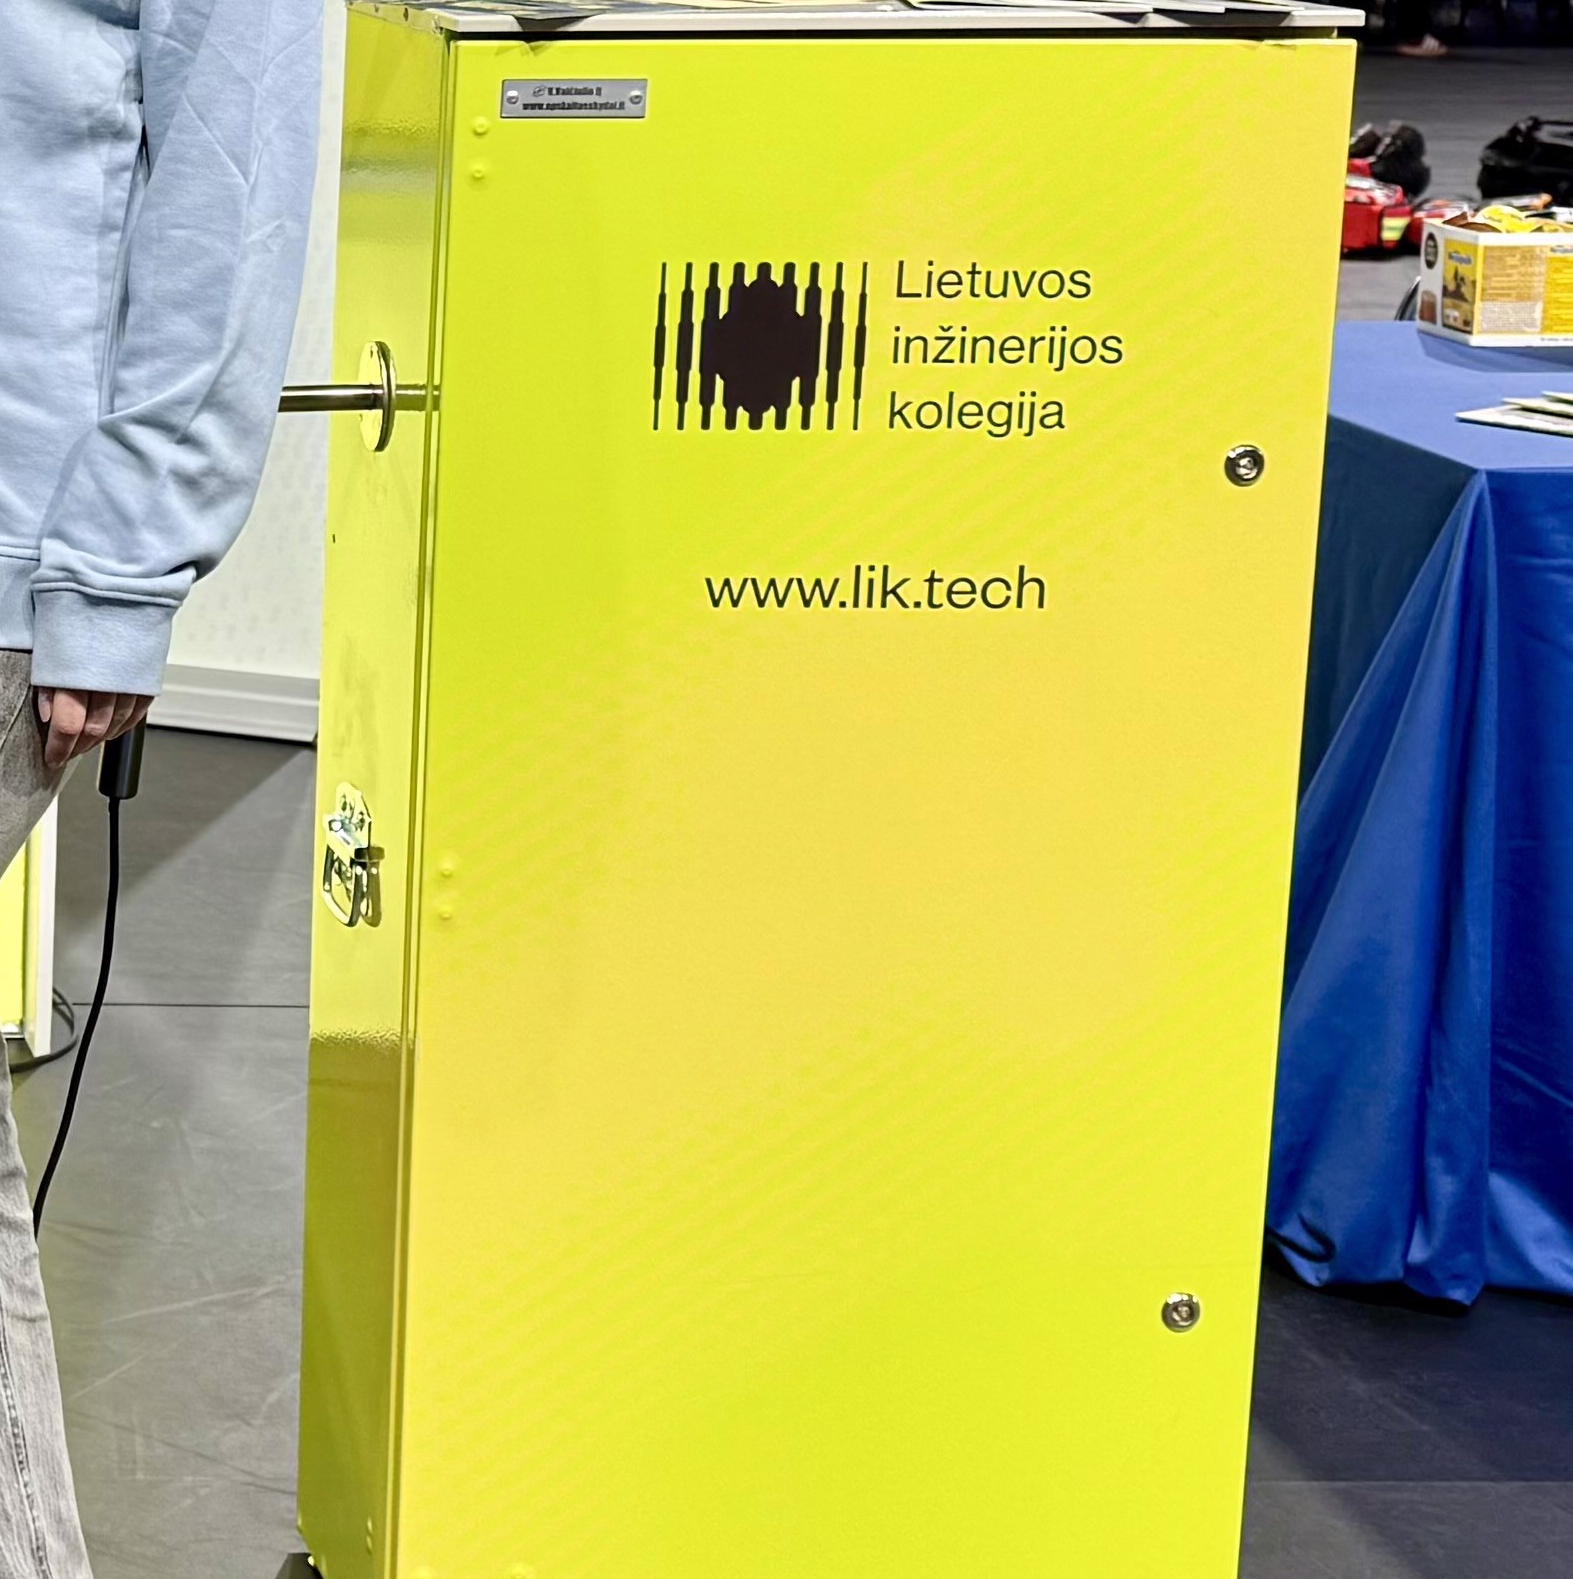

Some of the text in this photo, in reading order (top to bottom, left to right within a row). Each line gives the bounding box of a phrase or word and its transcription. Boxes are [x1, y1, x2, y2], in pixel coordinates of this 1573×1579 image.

[894, 259, 1094, 302] Lietuvos
[890, 323, 1126, 374] inžinerijos
[887, 390, 1067, 439] kolegija
[703, 565, 1048, 612] www.lik.tech
